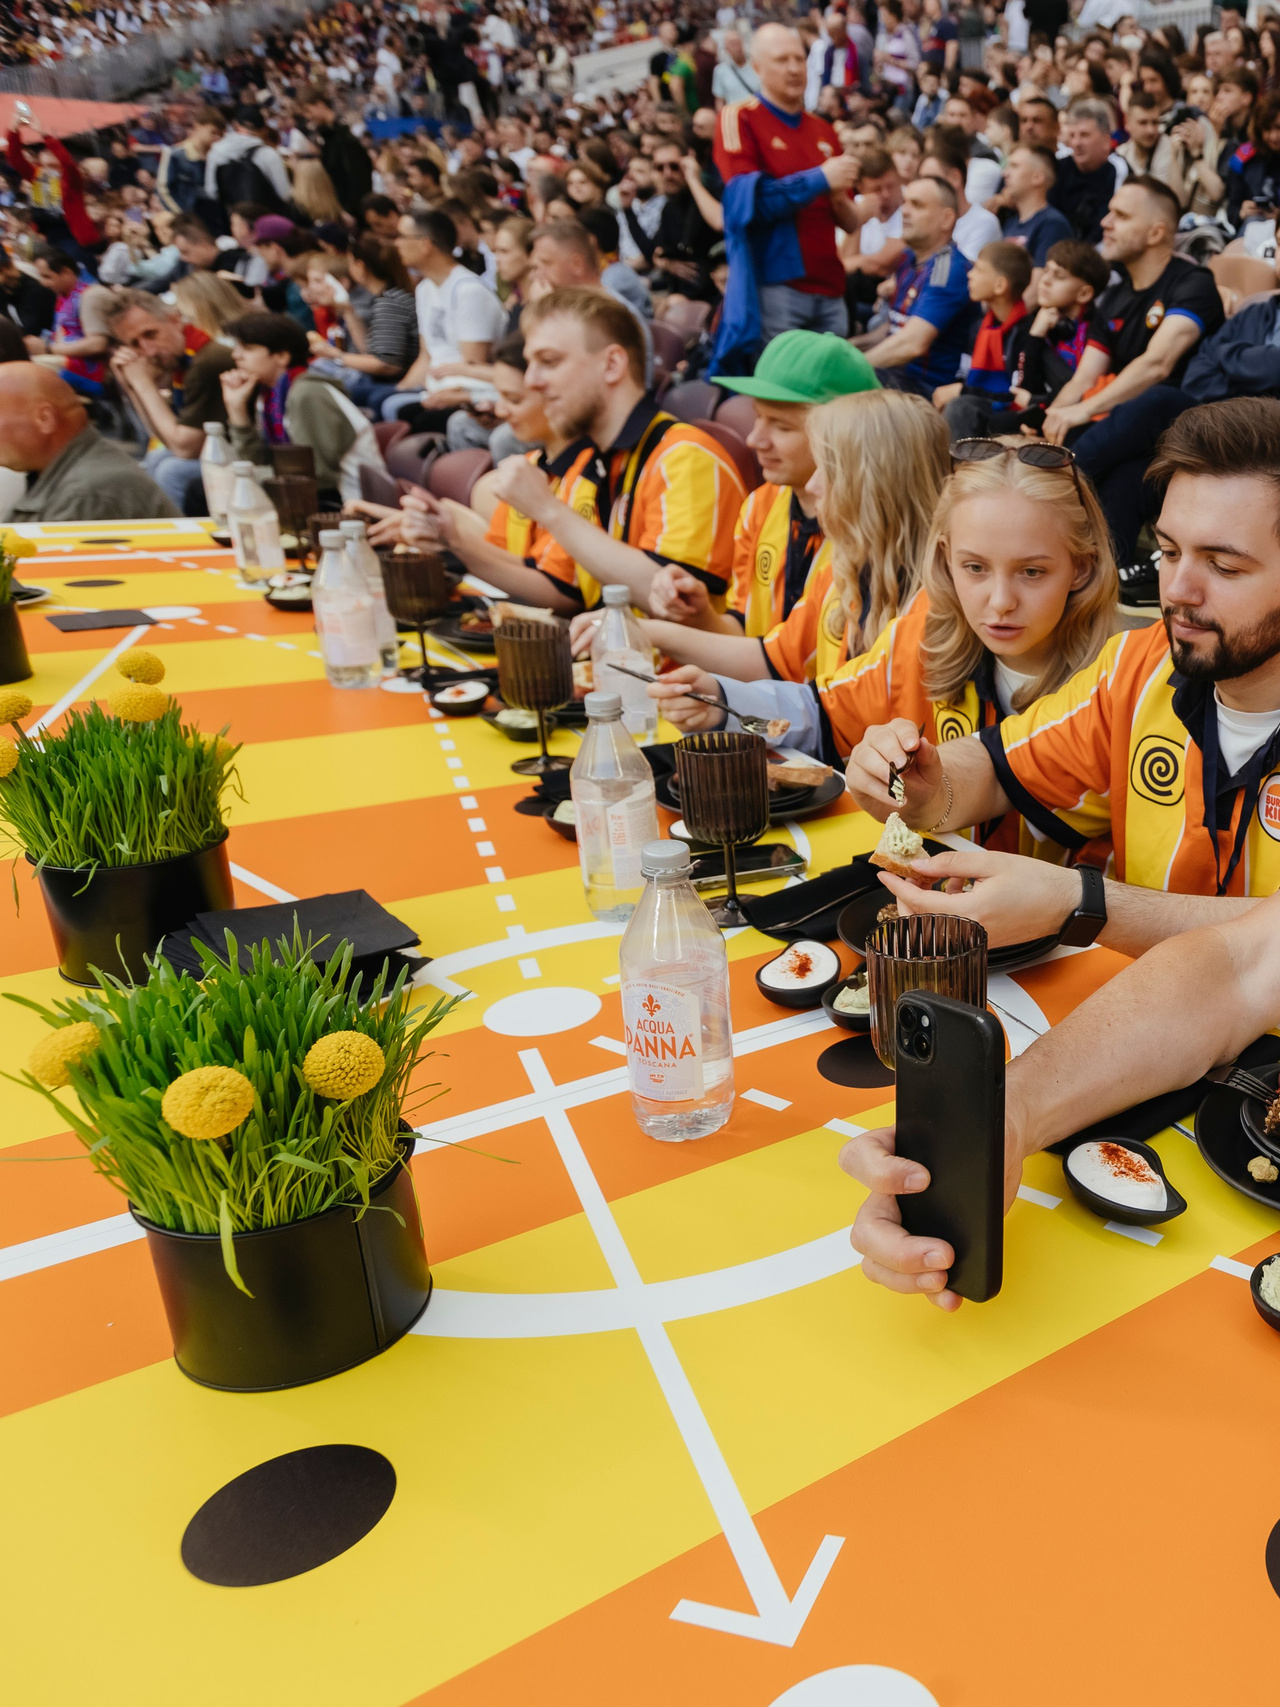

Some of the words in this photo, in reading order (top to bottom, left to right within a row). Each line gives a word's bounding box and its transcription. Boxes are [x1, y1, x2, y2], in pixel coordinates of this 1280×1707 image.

[636, 1018, 675, 1035] ACQUA
[625, 1024, 697, 1060] PANNA
[638, 1057, 678, 1068] TOSCANA
